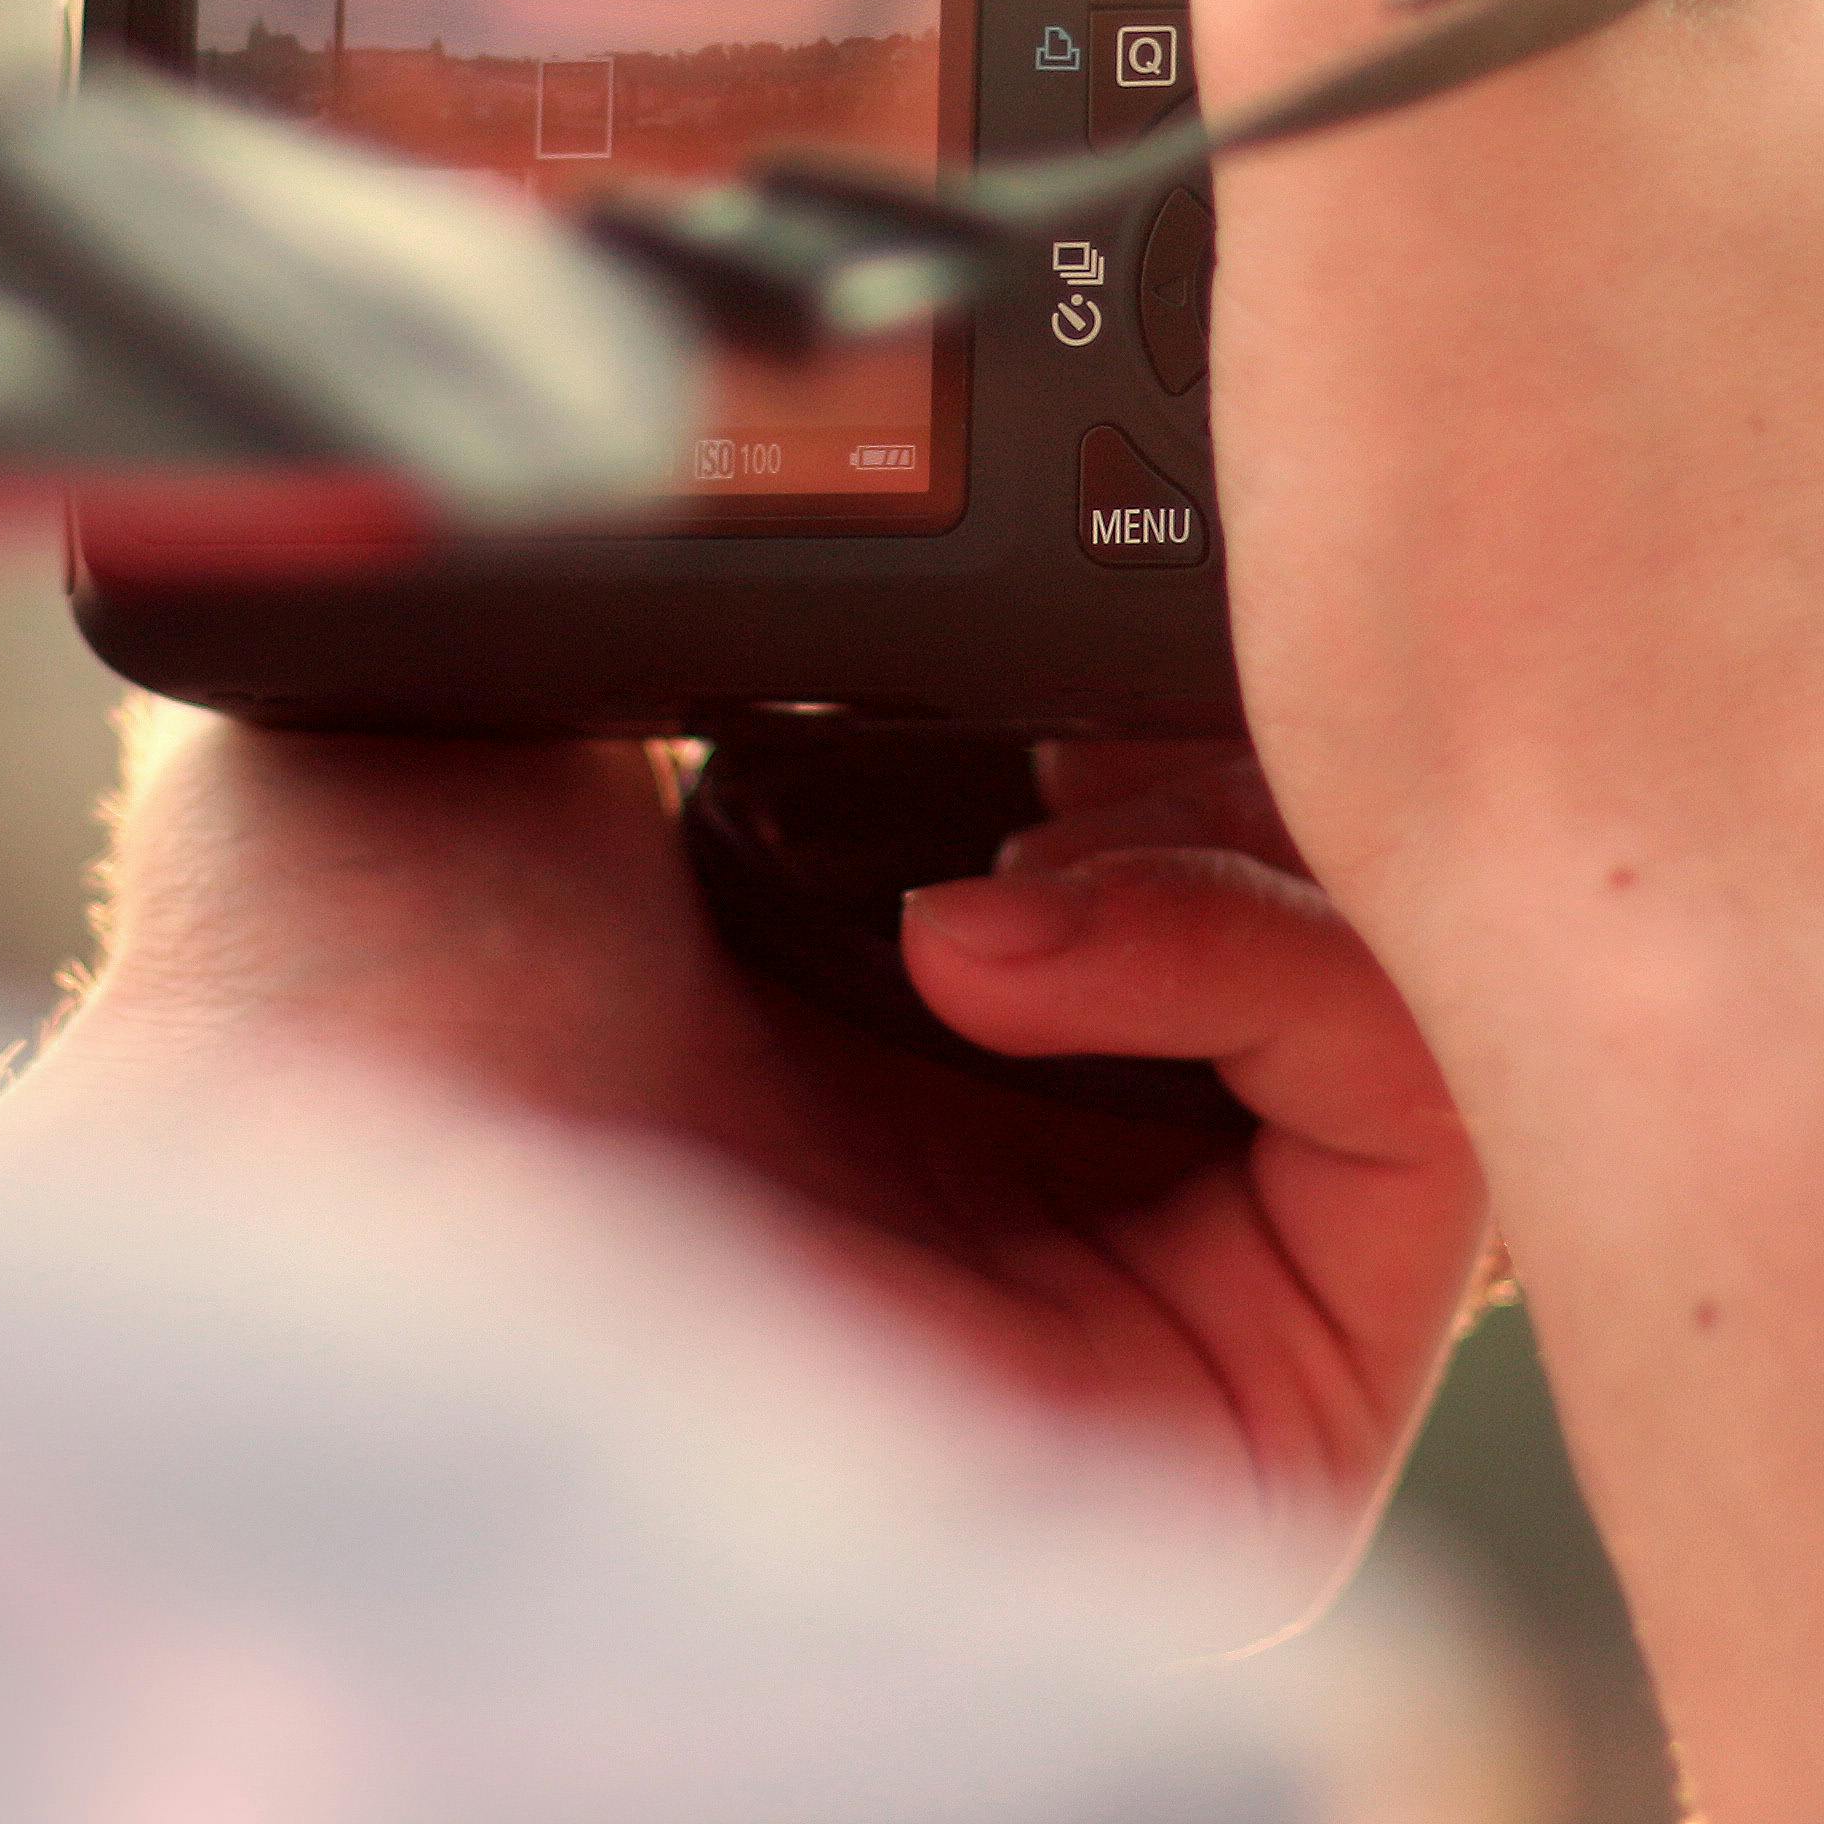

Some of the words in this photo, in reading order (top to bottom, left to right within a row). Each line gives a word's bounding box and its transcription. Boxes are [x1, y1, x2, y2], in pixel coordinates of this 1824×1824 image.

[1129, 36, 1162, 75] Q
[696, 441, 734, 477] ISO
[740, 442, 782, 475] 100
[1091, 508, 1191, 545] MENU
